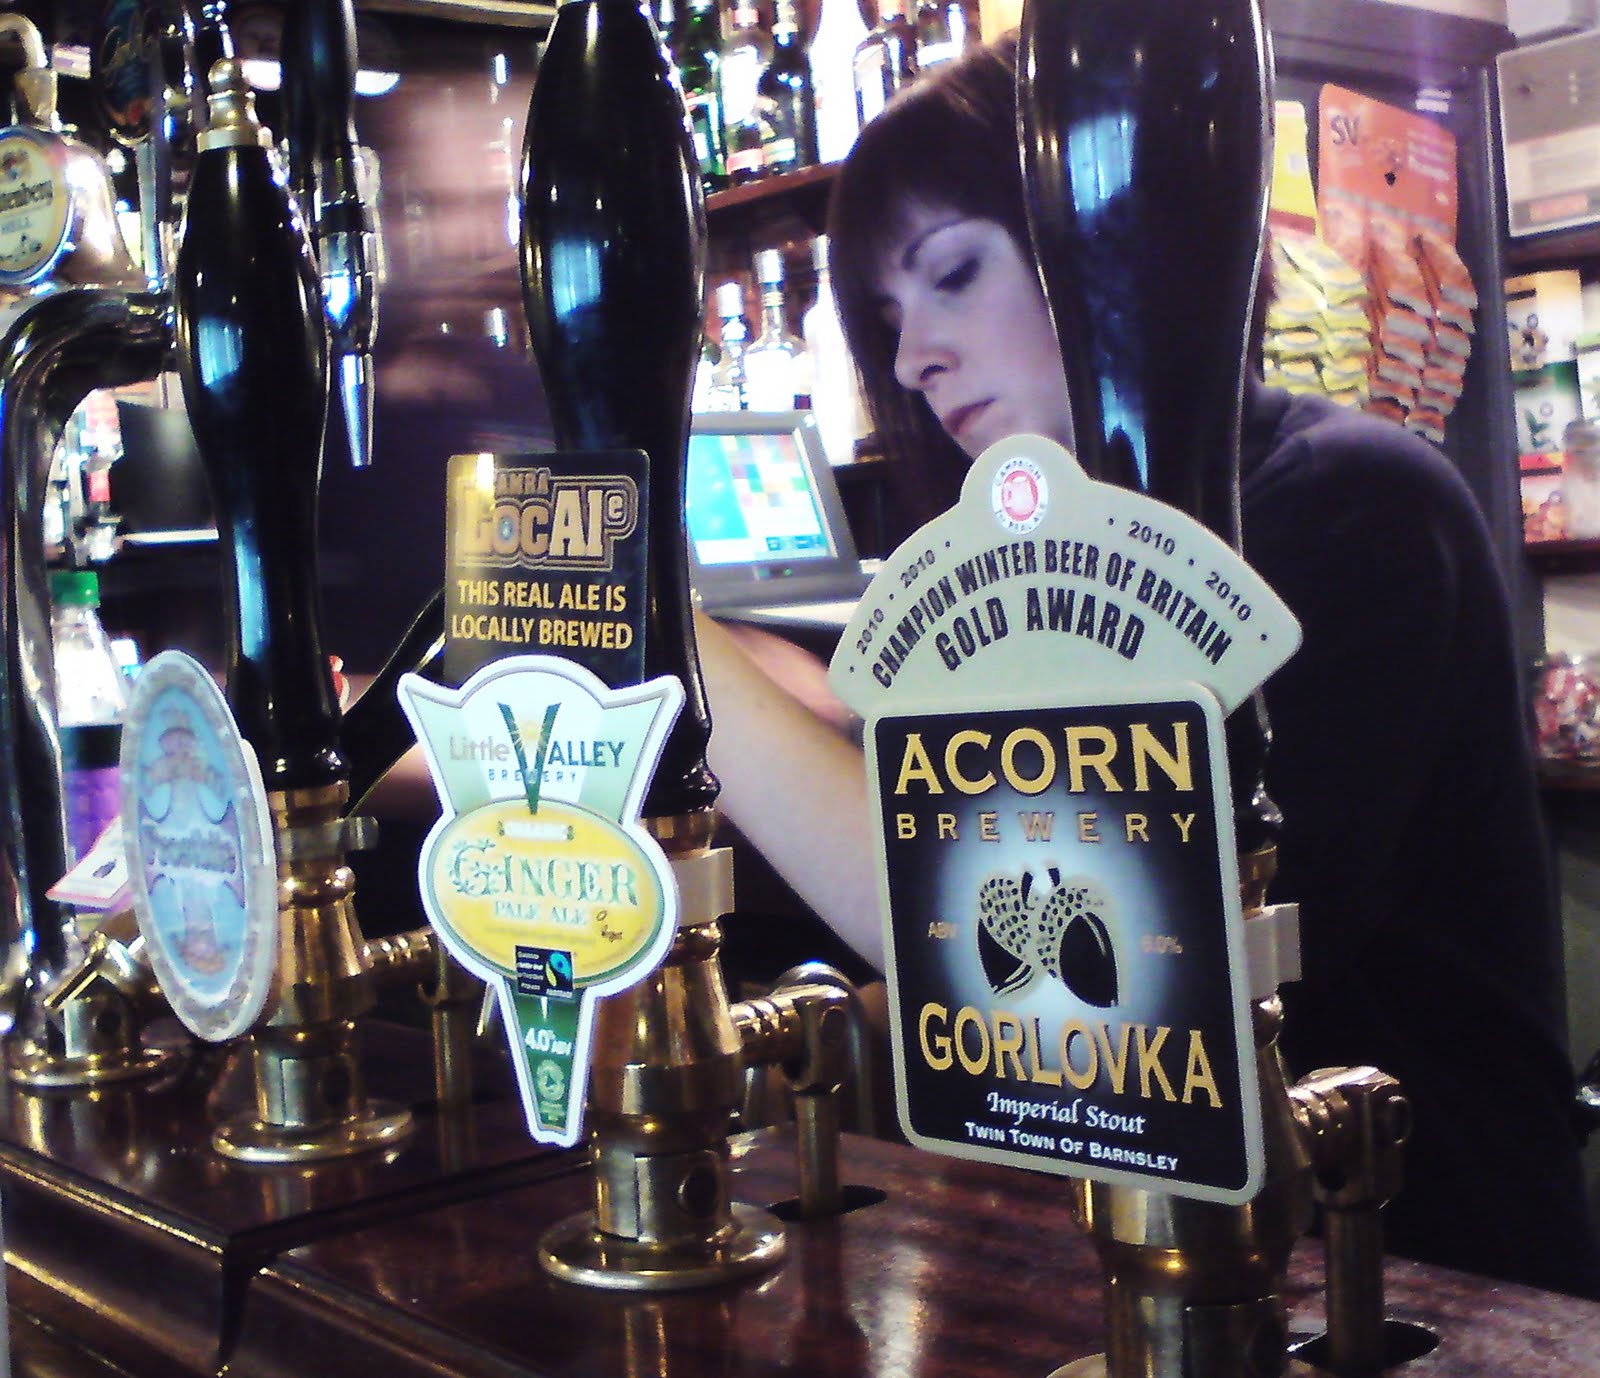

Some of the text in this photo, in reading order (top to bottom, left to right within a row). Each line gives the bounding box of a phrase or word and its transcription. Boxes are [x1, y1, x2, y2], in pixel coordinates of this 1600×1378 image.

[457, 580, 627, 612] THIS REAL ALE IS
[857, 520, 1252, 655] 2010 2010 2010 2010
[452, 614, 633, 649] LOCALLY BREWED
[872, 539, 1233, 689] CHAMPION WINTER BEER OF BRITAIN
[935, 587, 1145, 671] GOLD AWARD
[449, 733, 510, 762] Little
[894, 721, 1194, 796] ACORN
[895, 811, 1196, 843] BREWERY
[449, 838, 637, 906] GINGER
[495, 900, 588, 925] PALE ALE
[919, 1002, 1222, 1109] GORLOVKA
[987, 1091, 1146, 1135] Imperial Stout
[965, 1121, 1005, 1143] TWIN
[1009, 1128, 1055, 1151] TOWN
[1089, 1141, 1178, 1172] BARNSLEY
